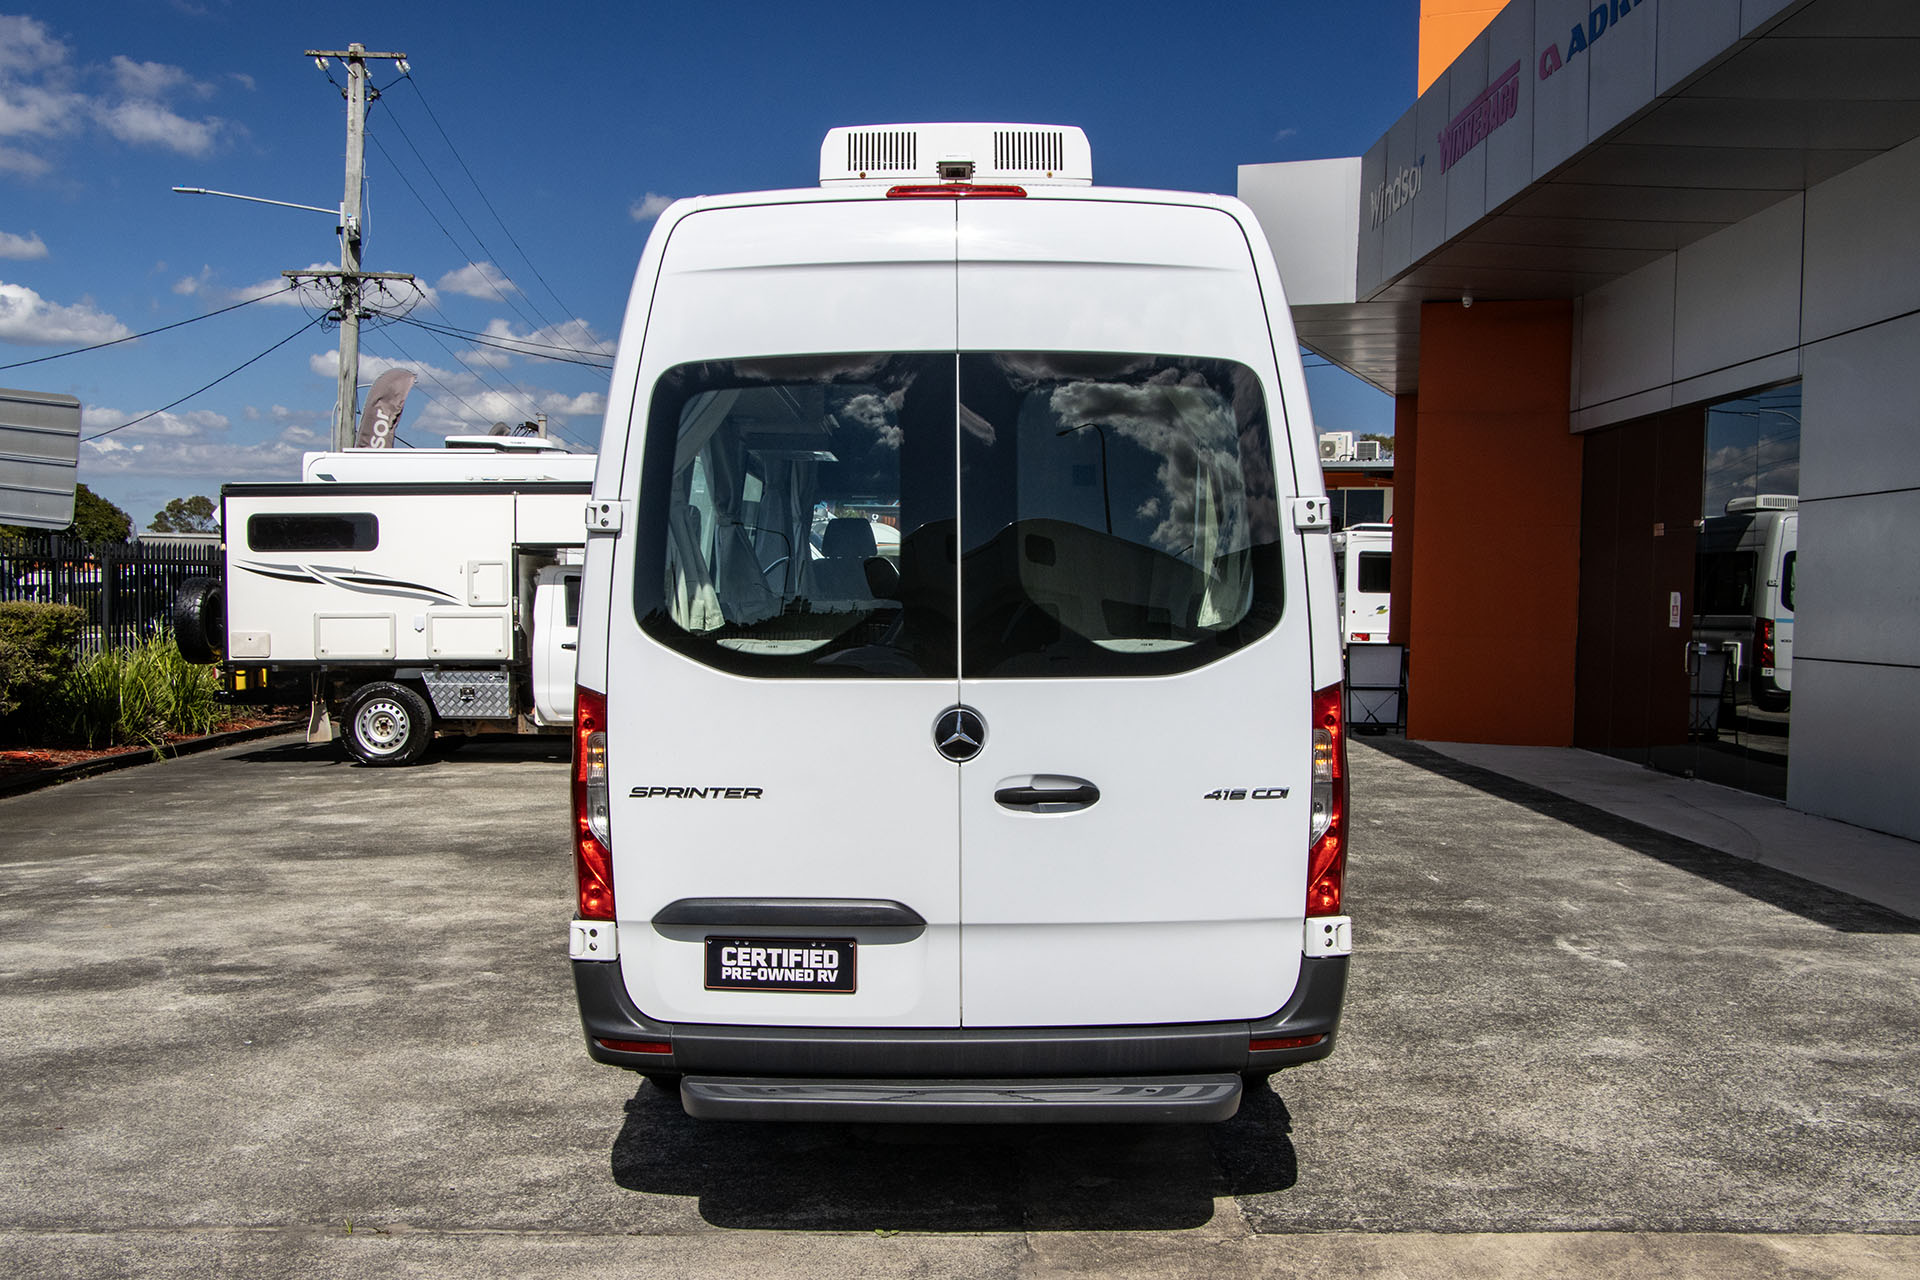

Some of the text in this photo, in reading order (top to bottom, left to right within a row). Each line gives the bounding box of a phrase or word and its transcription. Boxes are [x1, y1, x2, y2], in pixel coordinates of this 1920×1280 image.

[1566, 0, 1642, 63] ADR
[1438, 72, 1520, 175] WINNEBAGO
[629, 786, 763, 799] SPRINTER
[1204, 786, 1290, 801] 416 CDI
[721, 946, 839, 968] CERTIFIED
[721, 966, 838, 983] PRE-OWNED RV
